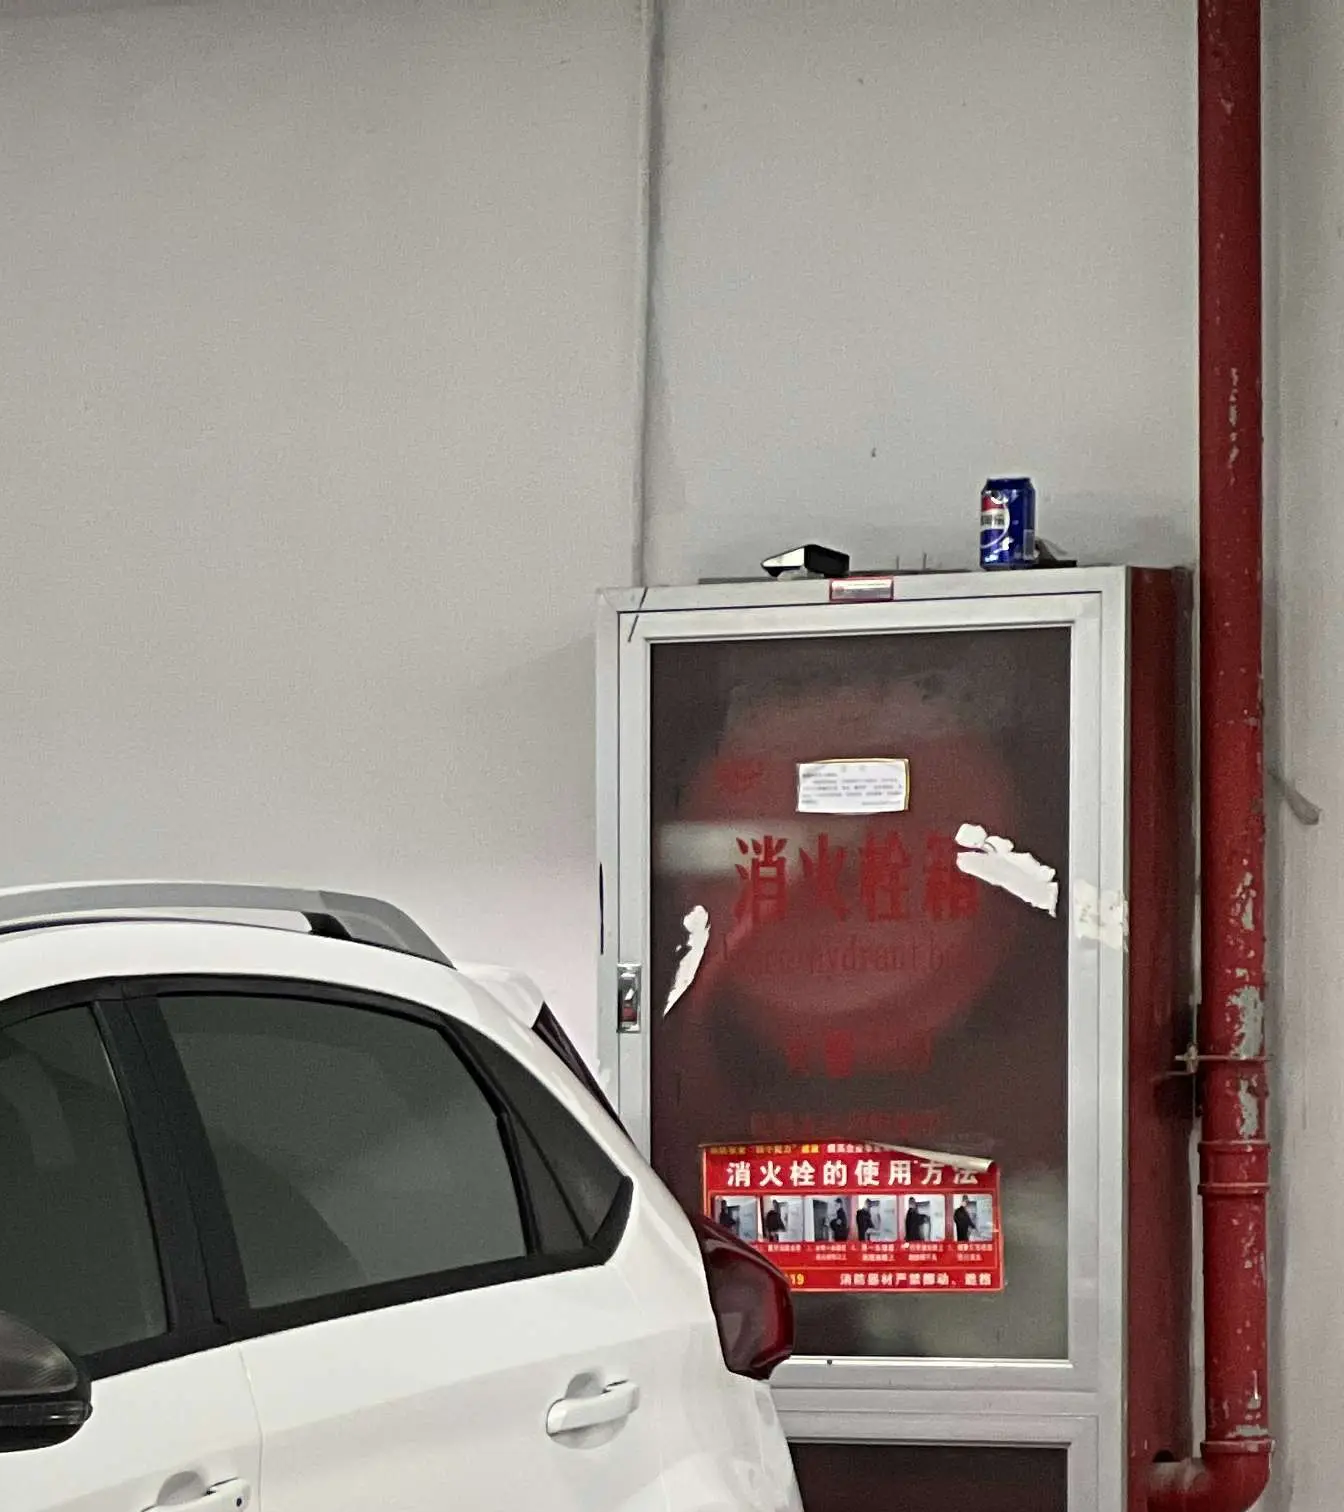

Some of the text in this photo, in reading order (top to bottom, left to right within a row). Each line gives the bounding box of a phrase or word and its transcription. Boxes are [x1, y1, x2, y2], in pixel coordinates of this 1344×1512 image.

[726, 1159, 980, 1187] 消火栓的使用方法
